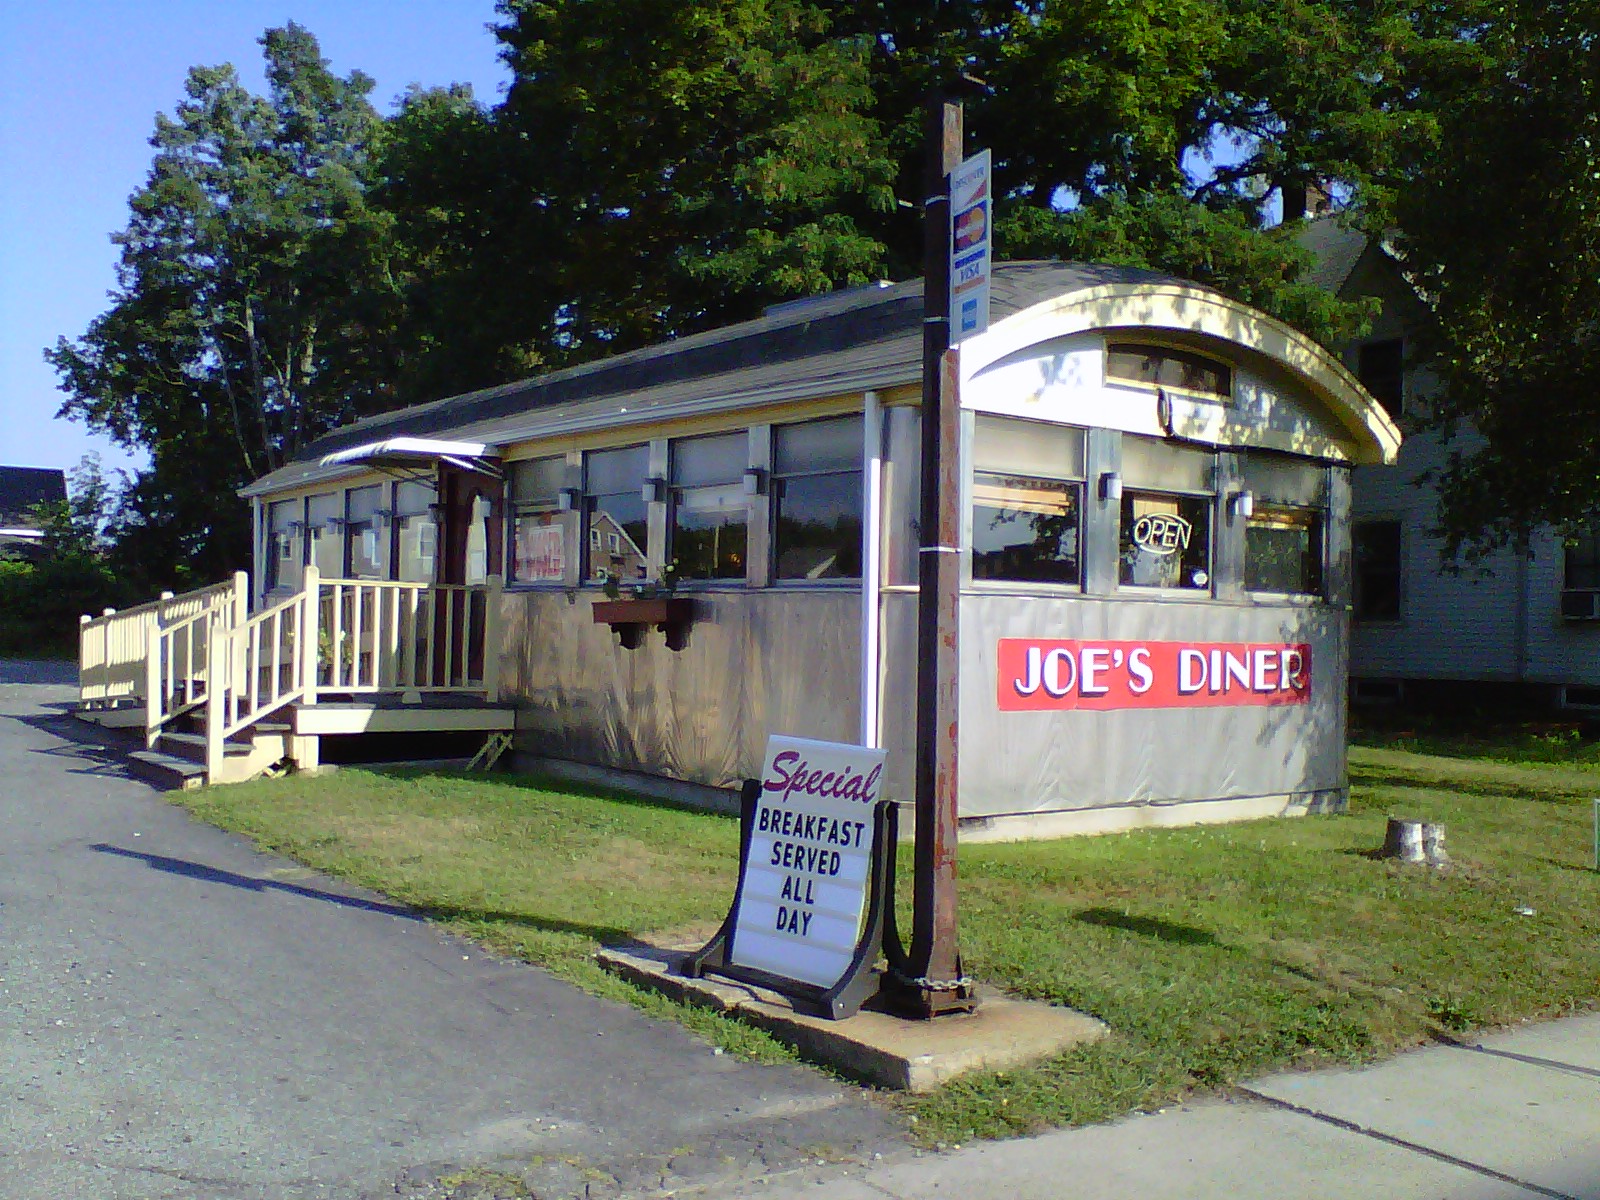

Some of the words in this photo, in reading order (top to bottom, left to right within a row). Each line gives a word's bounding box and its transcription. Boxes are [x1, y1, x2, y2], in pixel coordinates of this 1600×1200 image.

[1134, 518, 1193, 550] OPEN
[1014, 646, 1153, 695] JOE'S
[1178, 648, 1304, 694] DINER
[763, 750, 882, 802] Special
[759, 808, 865, 848] BREAKFAST
[771, 840, 842, 876] SERVED
[781, 875, 815, 905] ALL
[776, 906, 813, 937] DAY
